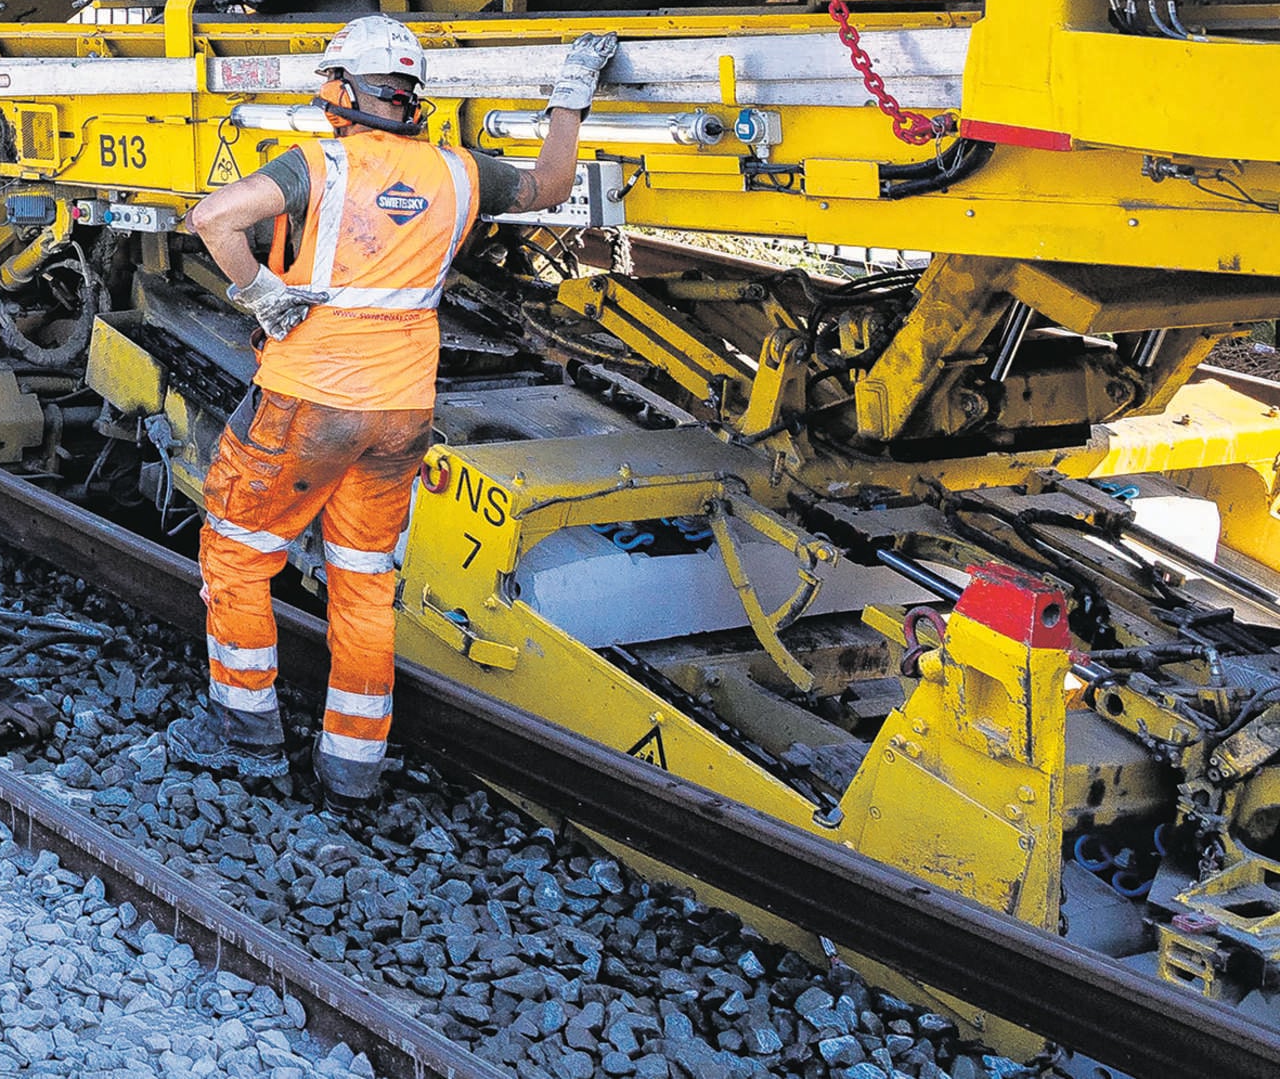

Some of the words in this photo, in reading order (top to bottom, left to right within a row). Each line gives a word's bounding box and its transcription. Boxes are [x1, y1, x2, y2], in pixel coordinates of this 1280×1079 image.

[100, 134, 147, 169] B13
[455, 467, 508, 527] NS
[462, 532, 482, 570] 7
